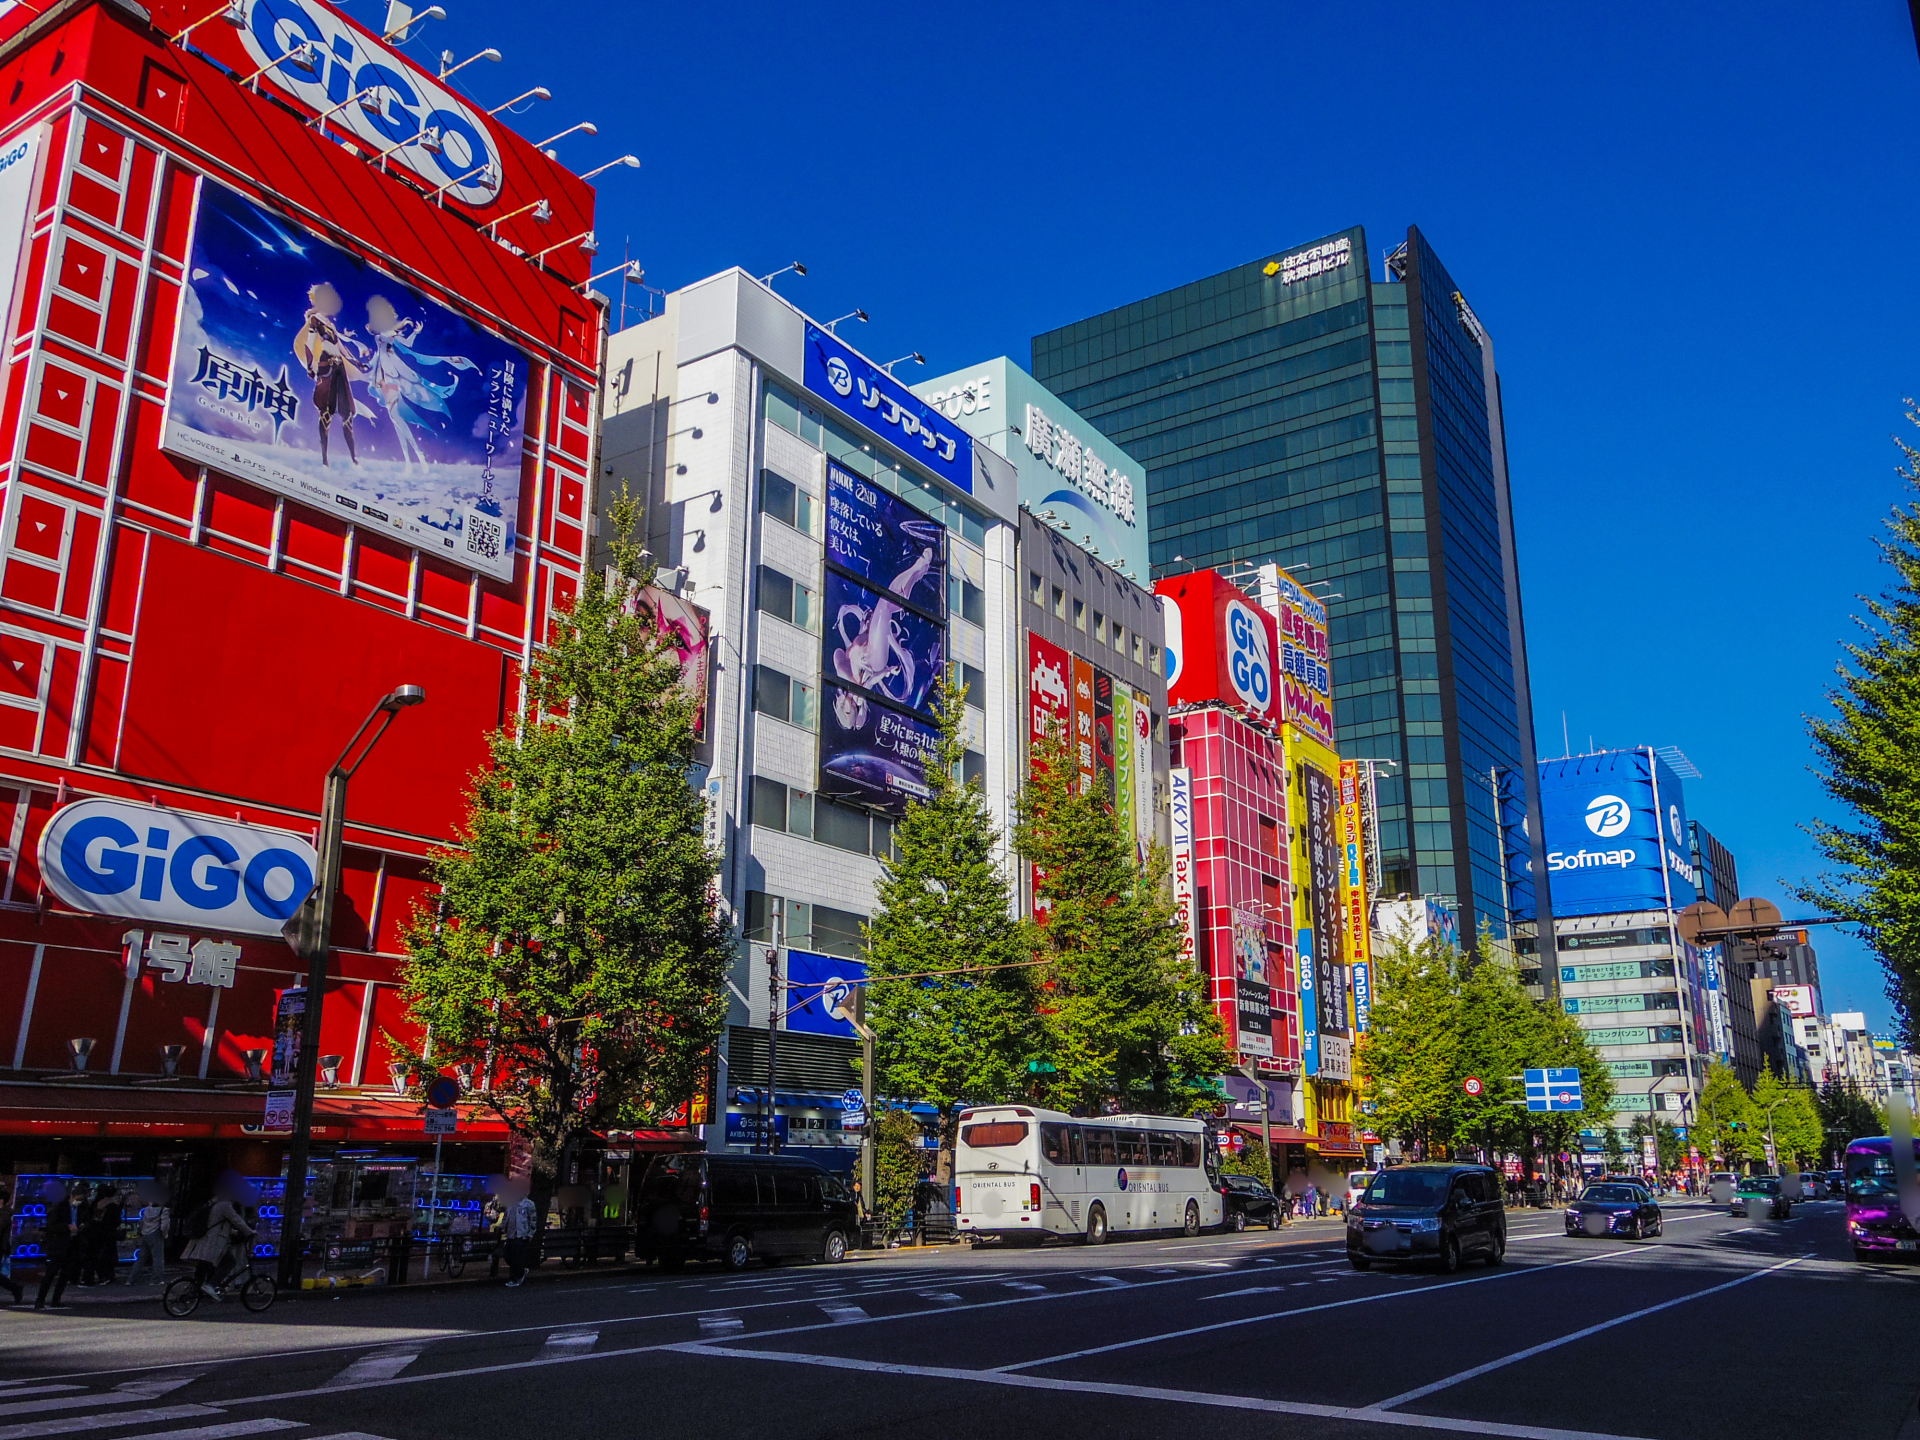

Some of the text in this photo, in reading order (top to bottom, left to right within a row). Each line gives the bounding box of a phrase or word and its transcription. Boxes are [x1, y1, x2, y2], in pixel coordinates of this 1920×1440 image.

[250, 0, 490, 189] GiGO
[1282, 253, 1349, 286] 秋葉原ビル
[1283, 237, 1350, 271] 住友不動産
[190, 344, 299, 446] 原神
[199, 397, 262, 430] Genshin
[481, 368, 503, 507] ブランニューワールドへ
[857, 377, 956, 461] ソフマップ
[243, 458, 331, 499] PS5 PS4 Windows
[830, 467, 854, 491] NIKKE
[830, 515, 862, 545] 彼女は、
[1280, 602, 1328, 663] 激安販売
[1282, 640, 1330, 697] 高額買取
[1284, 681, 1334, 739] Mulan
[1173, 774, 1188, 831] AKKY
[1344, 804, 1357, 844] ムーラン
[60, 816, 314, 920] GiGO
[1321, 784, 1338, 956] ヘブンバーンズレッド
[1546, 849, 1636, 872] Sofmap
[1175, 849, 1192, 934] Tax-free
[1310, 776, 1334, 1029] 世界の終わりと白の呪文
[121, 928, 242, 988] 1号館
[1301, 955, 1312, 991] GiGO
[1566, 1002, 1577, 1010] 6F
[1581, 998, 1640, 1007] ゲーミングデバイス
[1324, 1040, 1340, 1057] 12.13
[844, 1096, 861, 1105] 437
[1468, 1082, 1479, 1091] 50
[1128, 1182, 1169, 1192] ORIENTAL BUS
